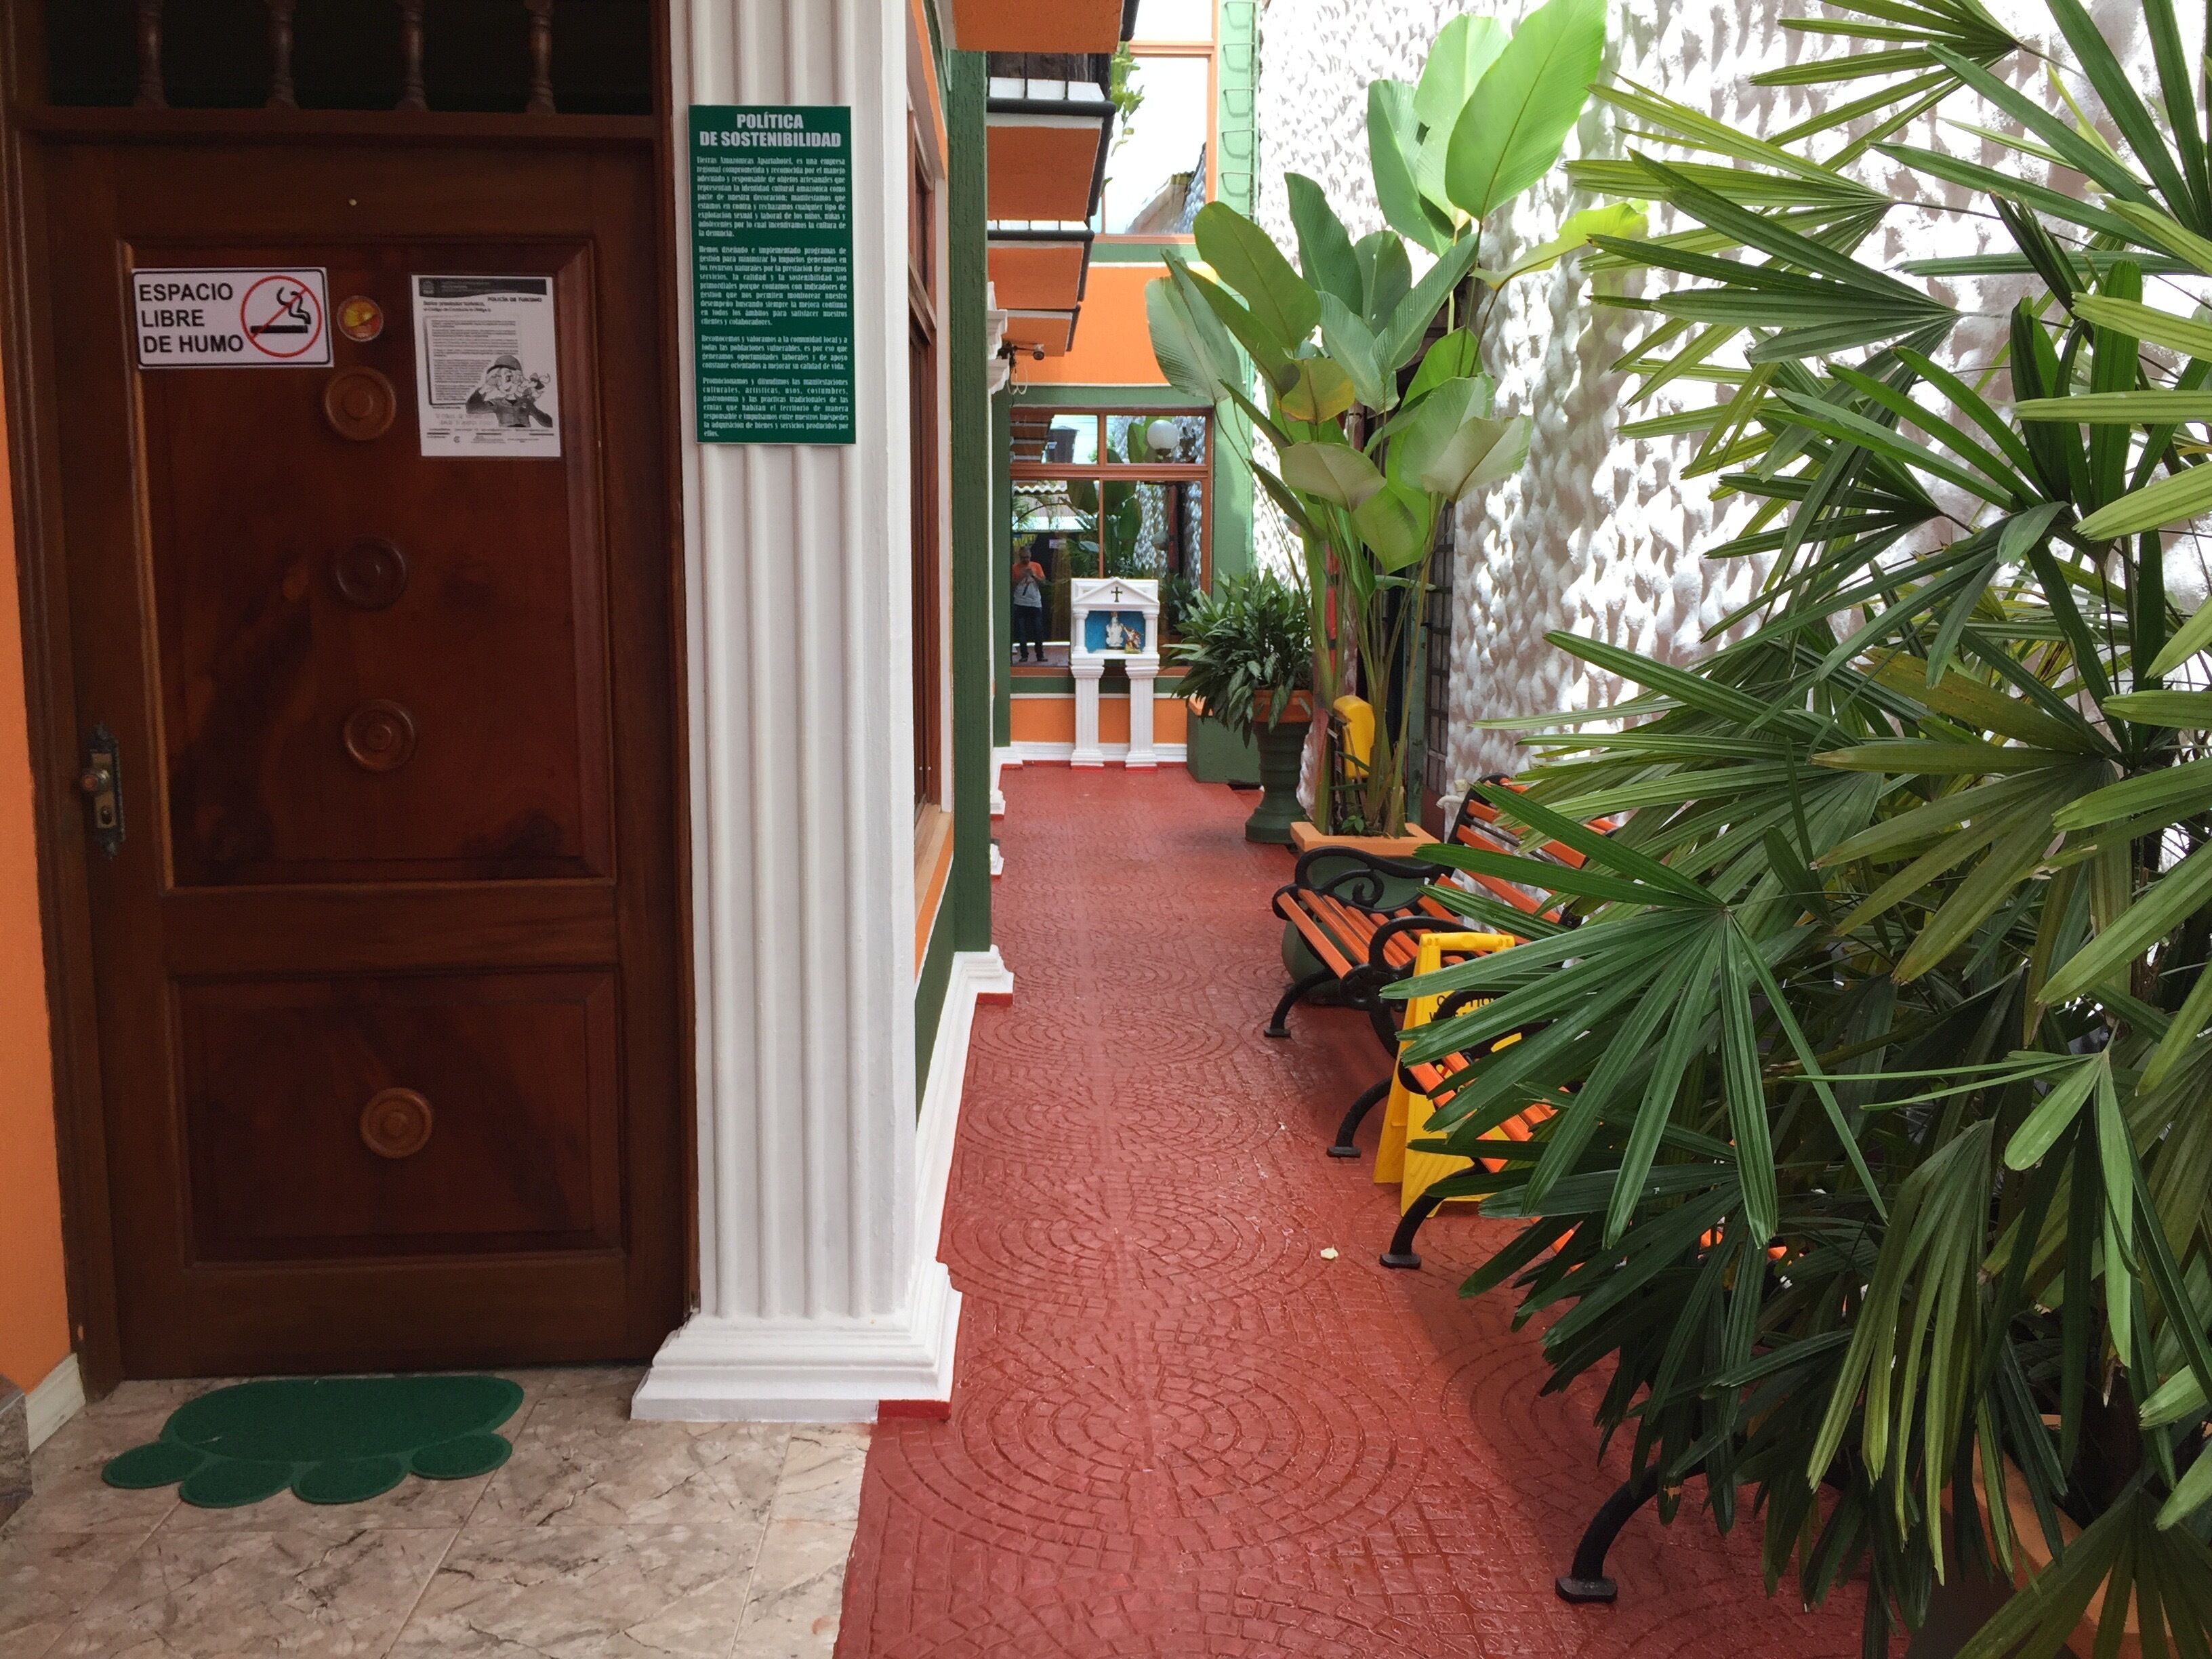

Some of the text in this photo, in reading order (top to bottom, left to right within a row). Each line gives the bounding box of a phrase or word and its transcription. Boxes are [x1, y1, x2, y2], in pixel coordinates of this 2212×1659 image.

[737, 111, 804, 129] POLÍTICA
[699, 131, 841, 147] DE SOSTENIBILIDAD
[139, 283, 233, 302] ESPACIO
[141, 309, 205, 328] LIBRE
[143, 334, 244, 353] DE HUMO
